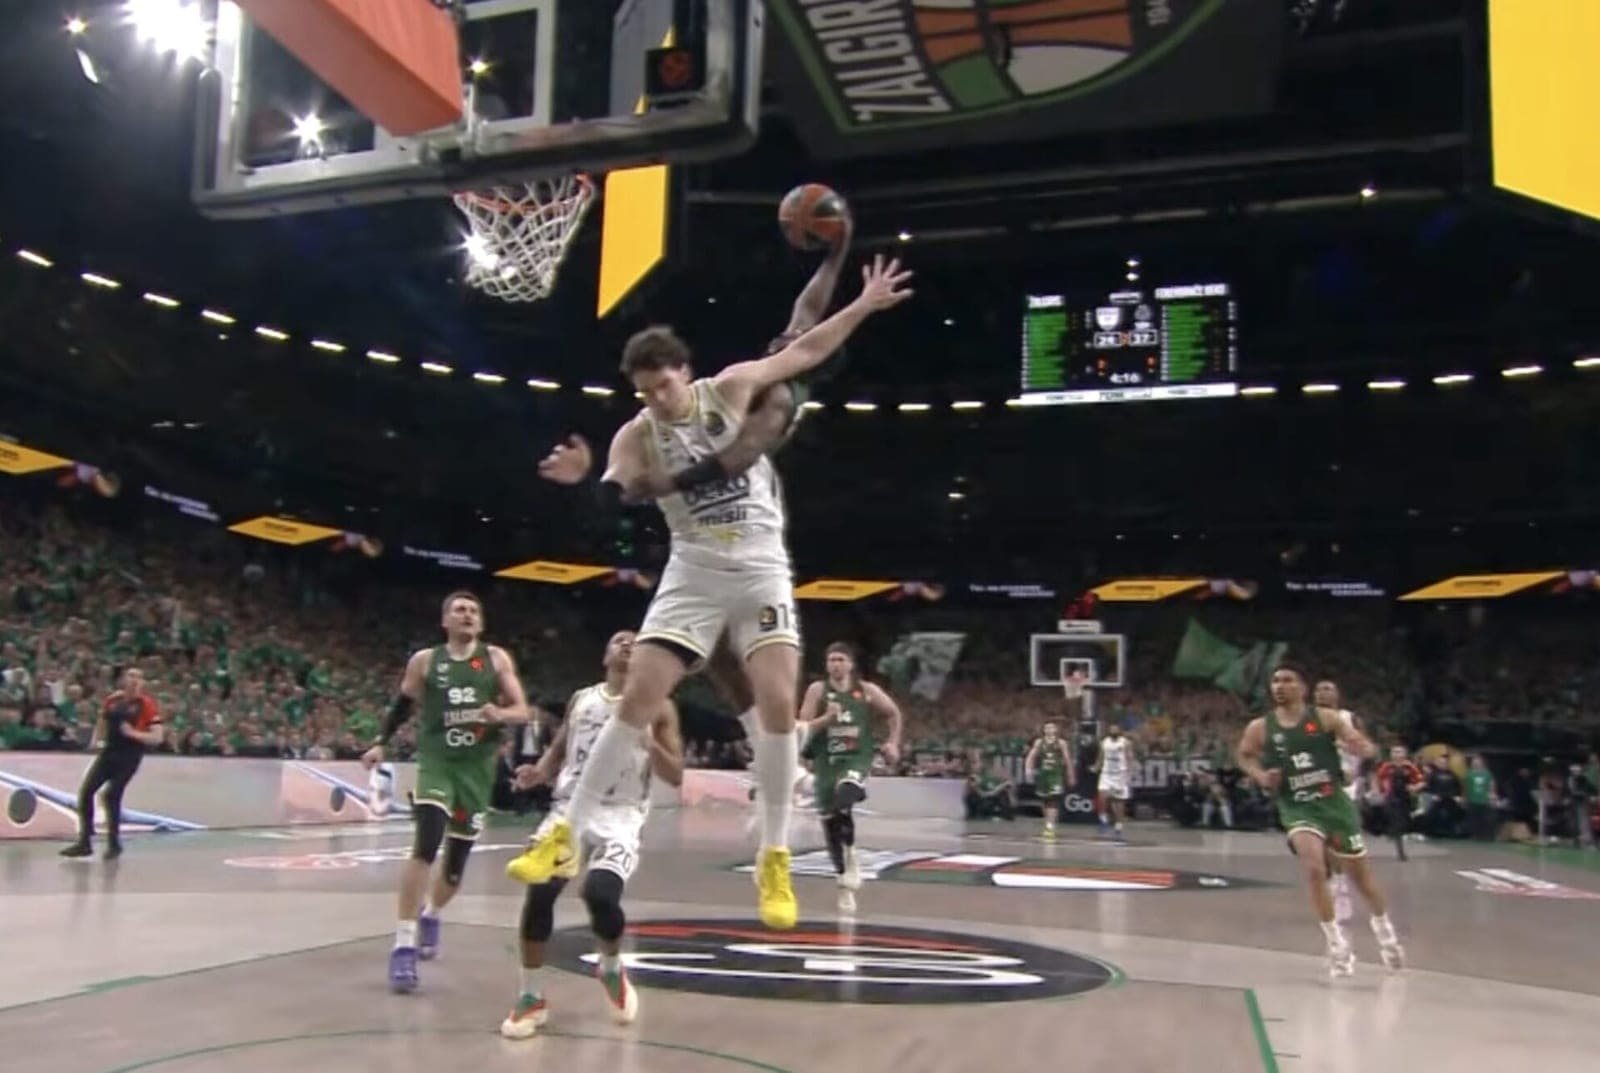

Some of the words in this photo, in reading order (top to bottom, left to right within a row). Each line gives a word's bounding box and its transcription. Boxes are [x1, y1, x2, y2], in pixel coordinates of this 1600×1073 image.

[448, 687, 476, 704] 92
[446, 728, 475, 746] Go
[1291, 752, 1313, 769] 12
[1064, 793, 1093, 812] Go
